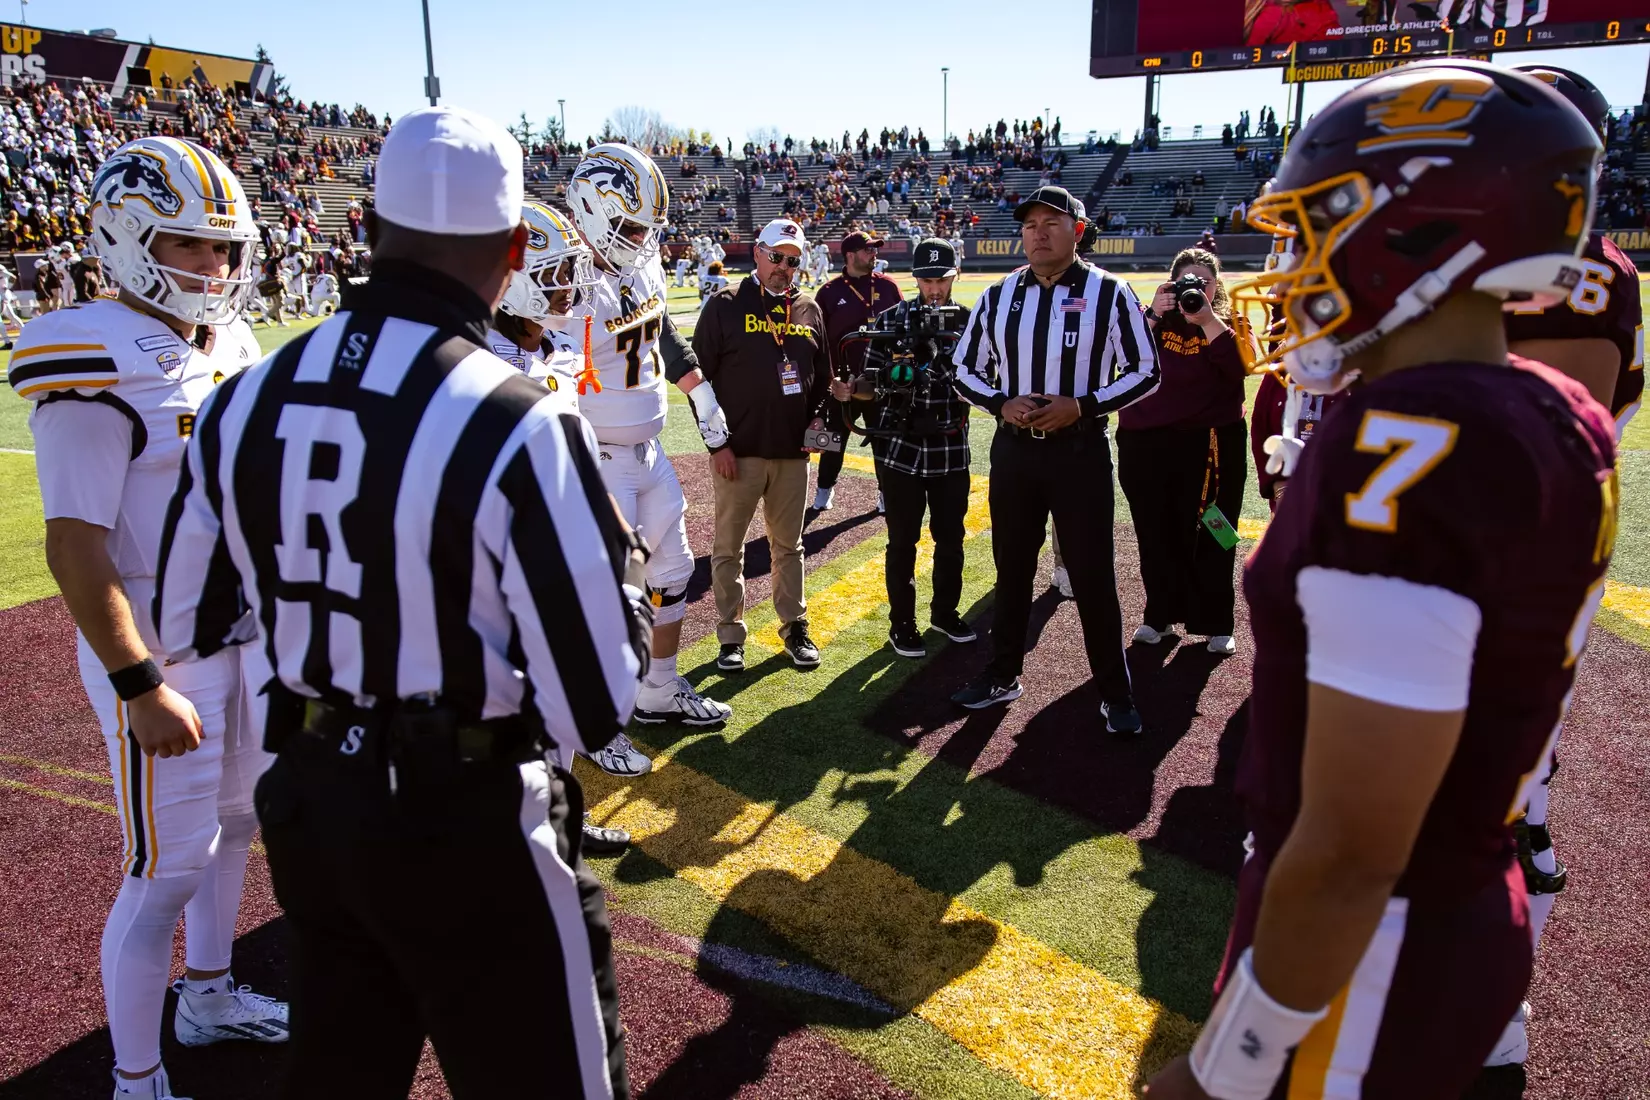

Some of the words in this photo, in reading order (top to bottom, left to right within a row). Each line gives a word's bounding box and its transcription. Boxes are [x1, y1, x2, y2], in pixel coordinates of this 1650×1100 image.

[1326, 28, 1343, 36] AND
[1345, 24, 1388, 35] DIRECTOR
[1390, 22, 1401, 31] OF
[2, 27, 41, 53] UP
[1373, 36, 1412, 55] 0:15
[1143, 58, 1161, 67] CMU
[1252, 48, 1261, 62] 3
[1348, 61, 1394, 79] FAMILY
[208, 217, 237, 229] GRIT
[976, 240, 1011, 254] KELLY
[1093, 239, 1135, 254] ADIUM
[703, 282, 719, 295] 24
[745, 314, 812, 337] Broncos
[1064, 332, 1077, 347] U
[1344, 408, 1460, 533] 7
[275, 403, 366, 600] R
